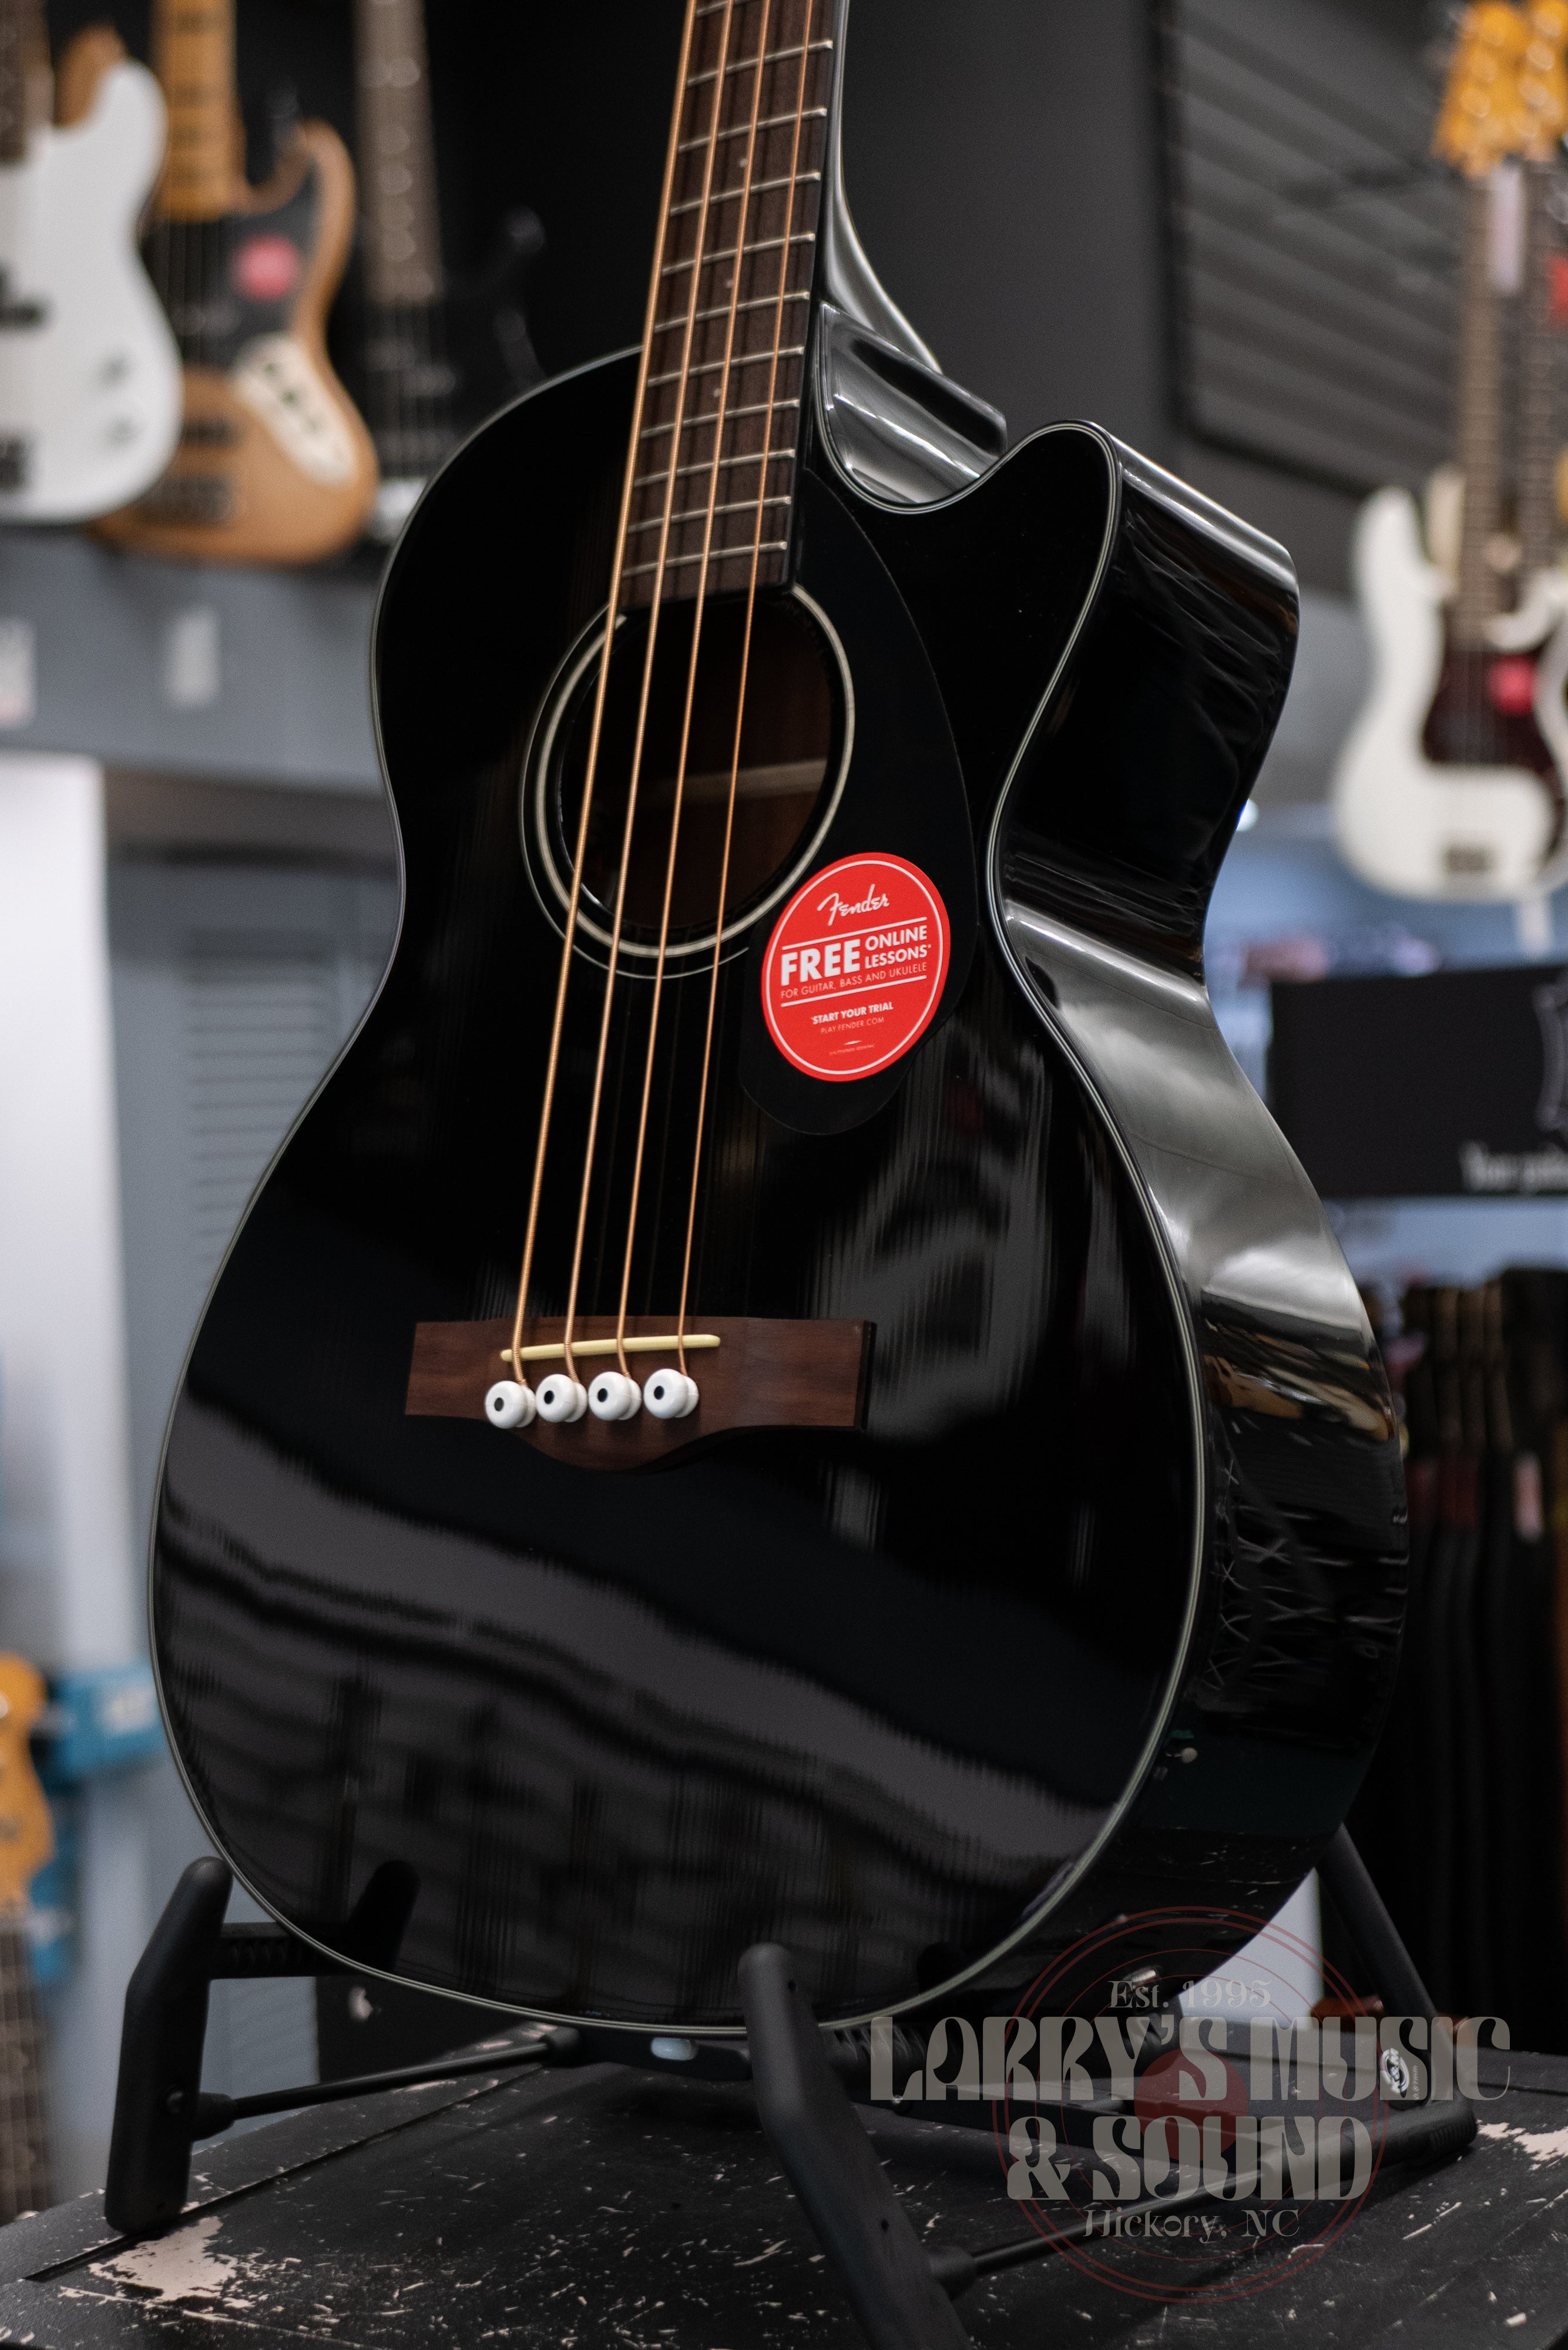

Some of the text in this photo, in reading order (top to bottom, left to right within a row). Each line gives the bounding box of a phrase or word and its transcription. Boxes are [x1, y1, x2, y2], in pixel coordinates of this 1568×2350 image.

[817, 884, 890, 926] Fender
[865, 925, 928, 952] ONLINE
[780, 962, 928, 999] FOR GUITAR, BASS AND UKULELE
[781, 938, 861, 987] FREE
[841, 1006, 867, 1019] YOUR
[868, 1001, 894, 1015] TRIAL
